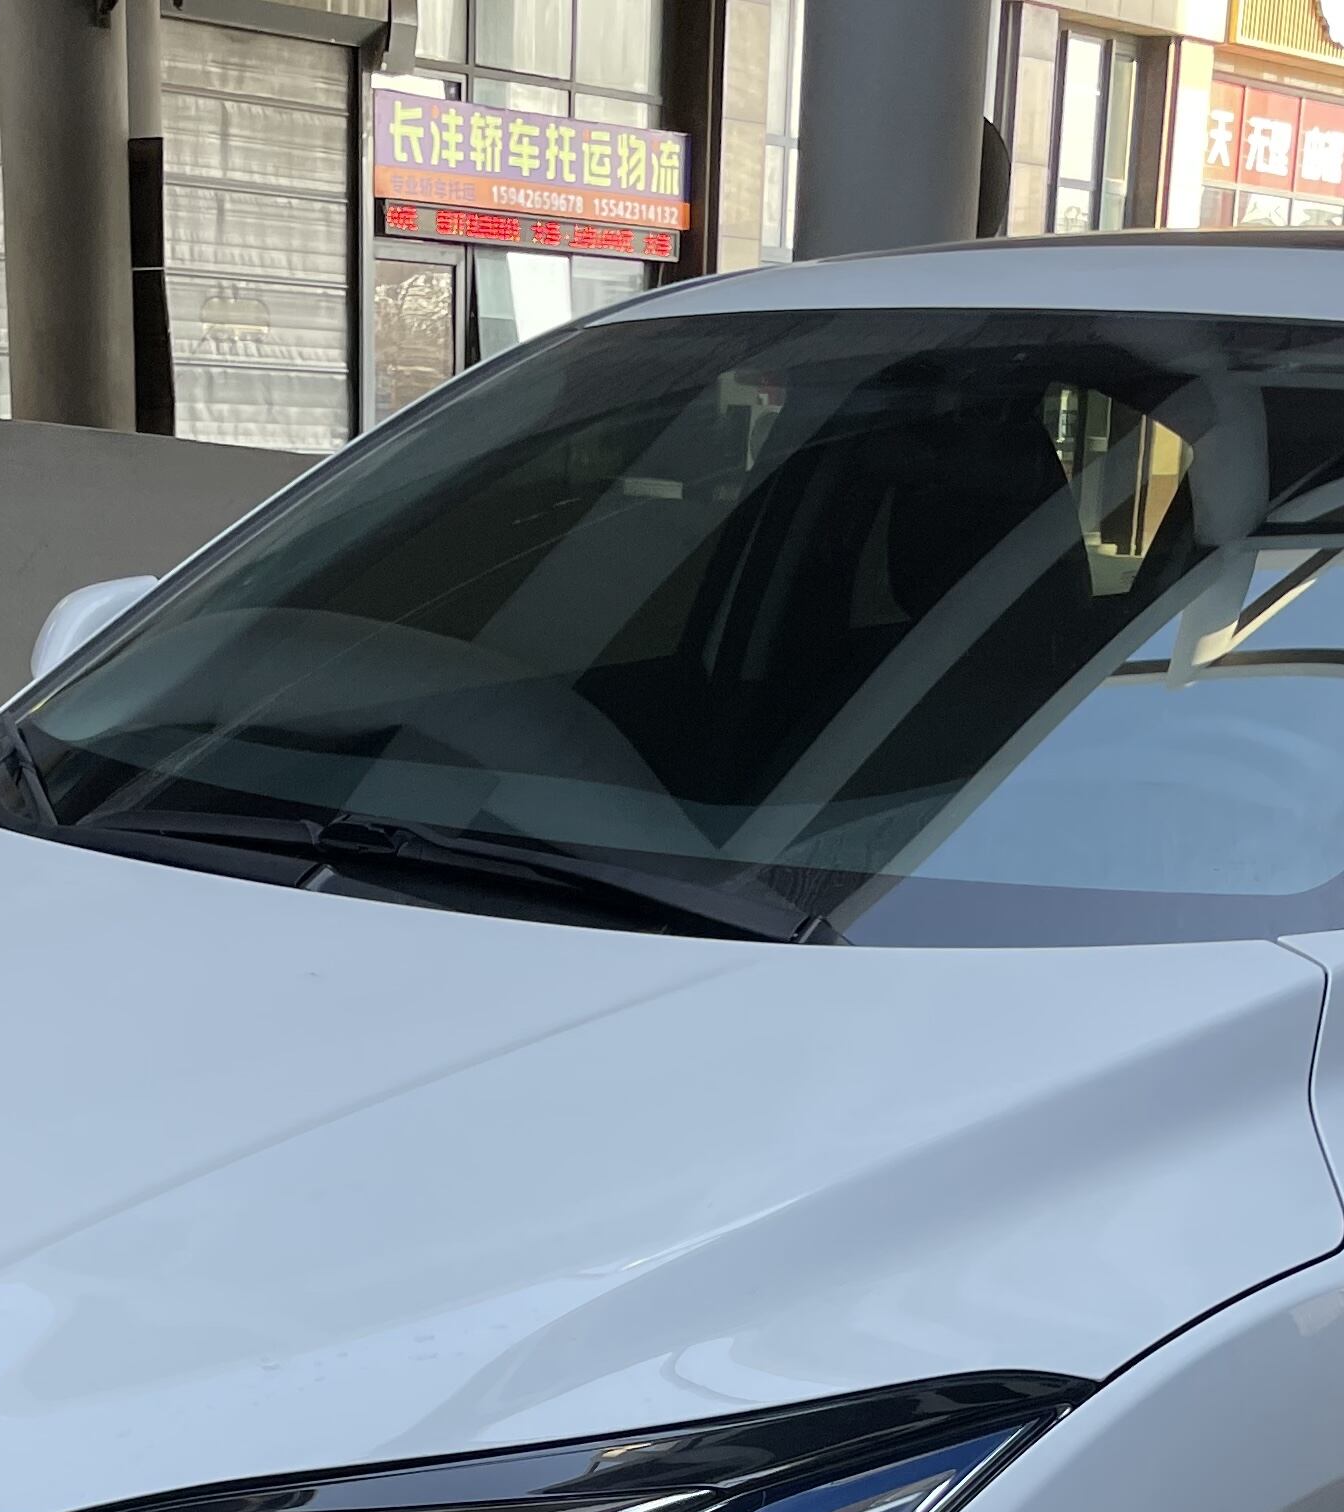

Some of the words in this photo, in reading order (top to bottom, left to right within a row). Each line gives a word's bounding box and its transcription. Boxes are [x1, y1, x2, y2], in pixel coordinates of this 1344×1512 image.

[389, 99, 682, 196] 长沣轿车托运物流
[491, 185, 584, 214] 15942659678
[593, 198, 678, 225] 15542314132
